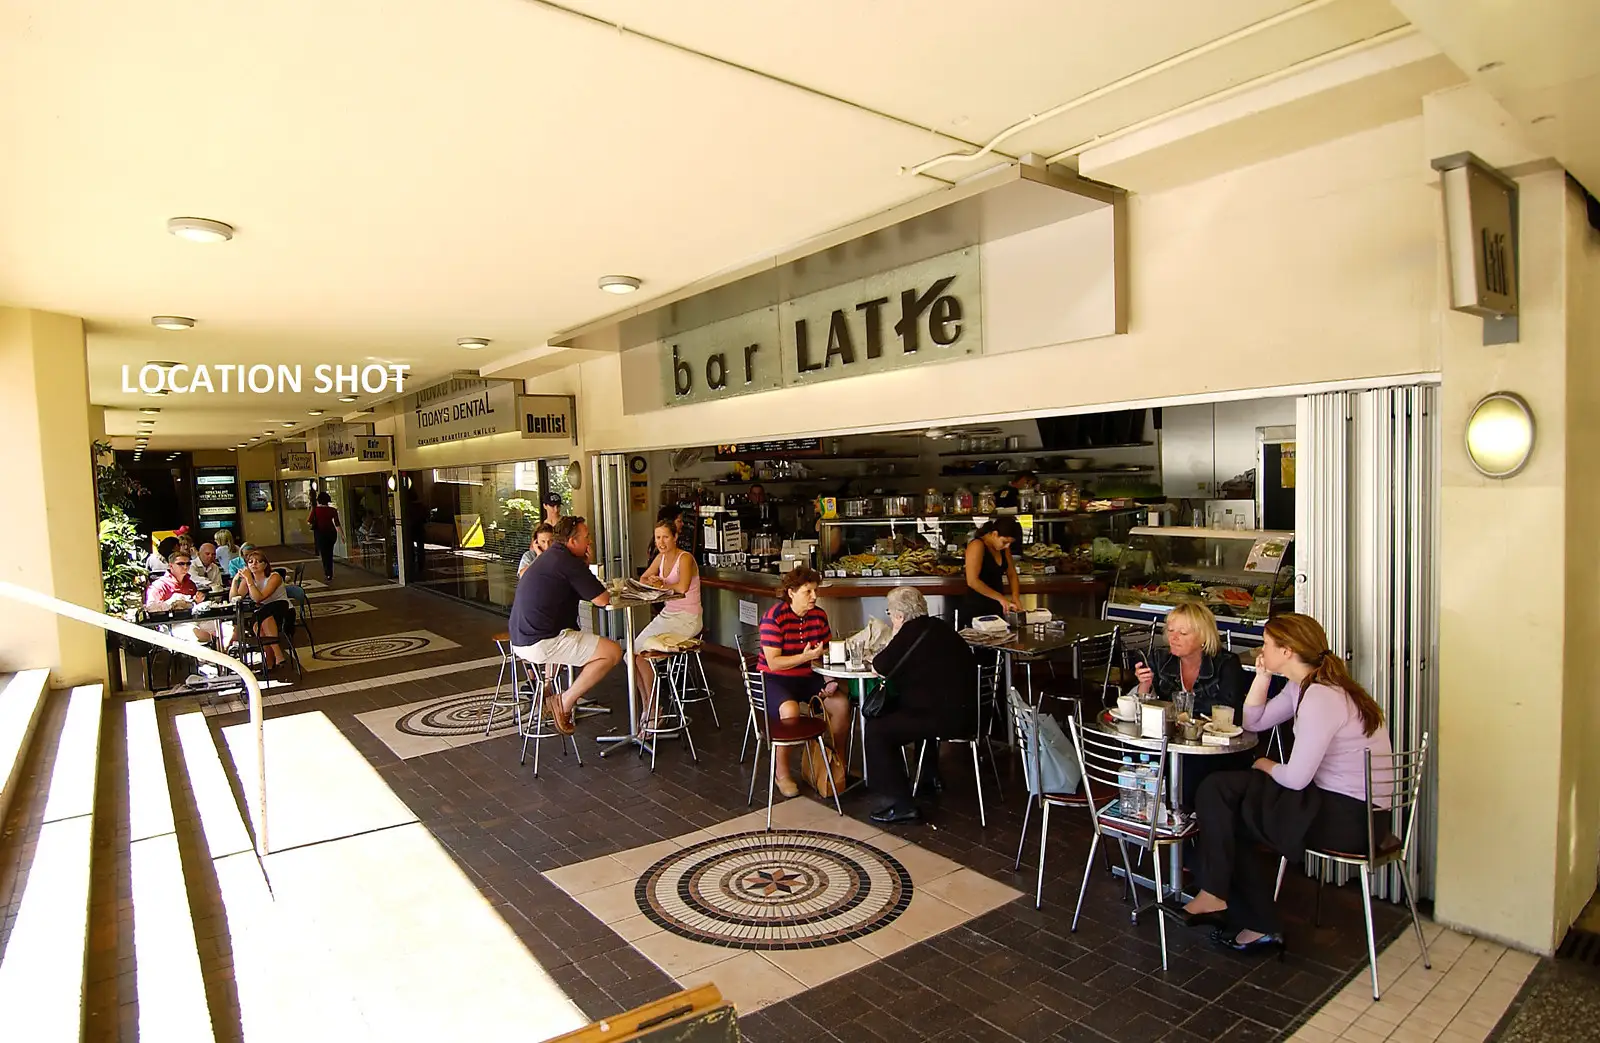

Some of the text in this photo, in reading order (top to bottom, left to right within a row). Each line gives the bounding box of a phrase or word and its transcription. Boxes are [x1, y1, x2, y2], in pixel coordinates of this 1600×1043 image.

[672, 343, 759, 397] bar
[453, 391, 494, 421] DENTAL
[526, 413, 567, 434] Dentist
